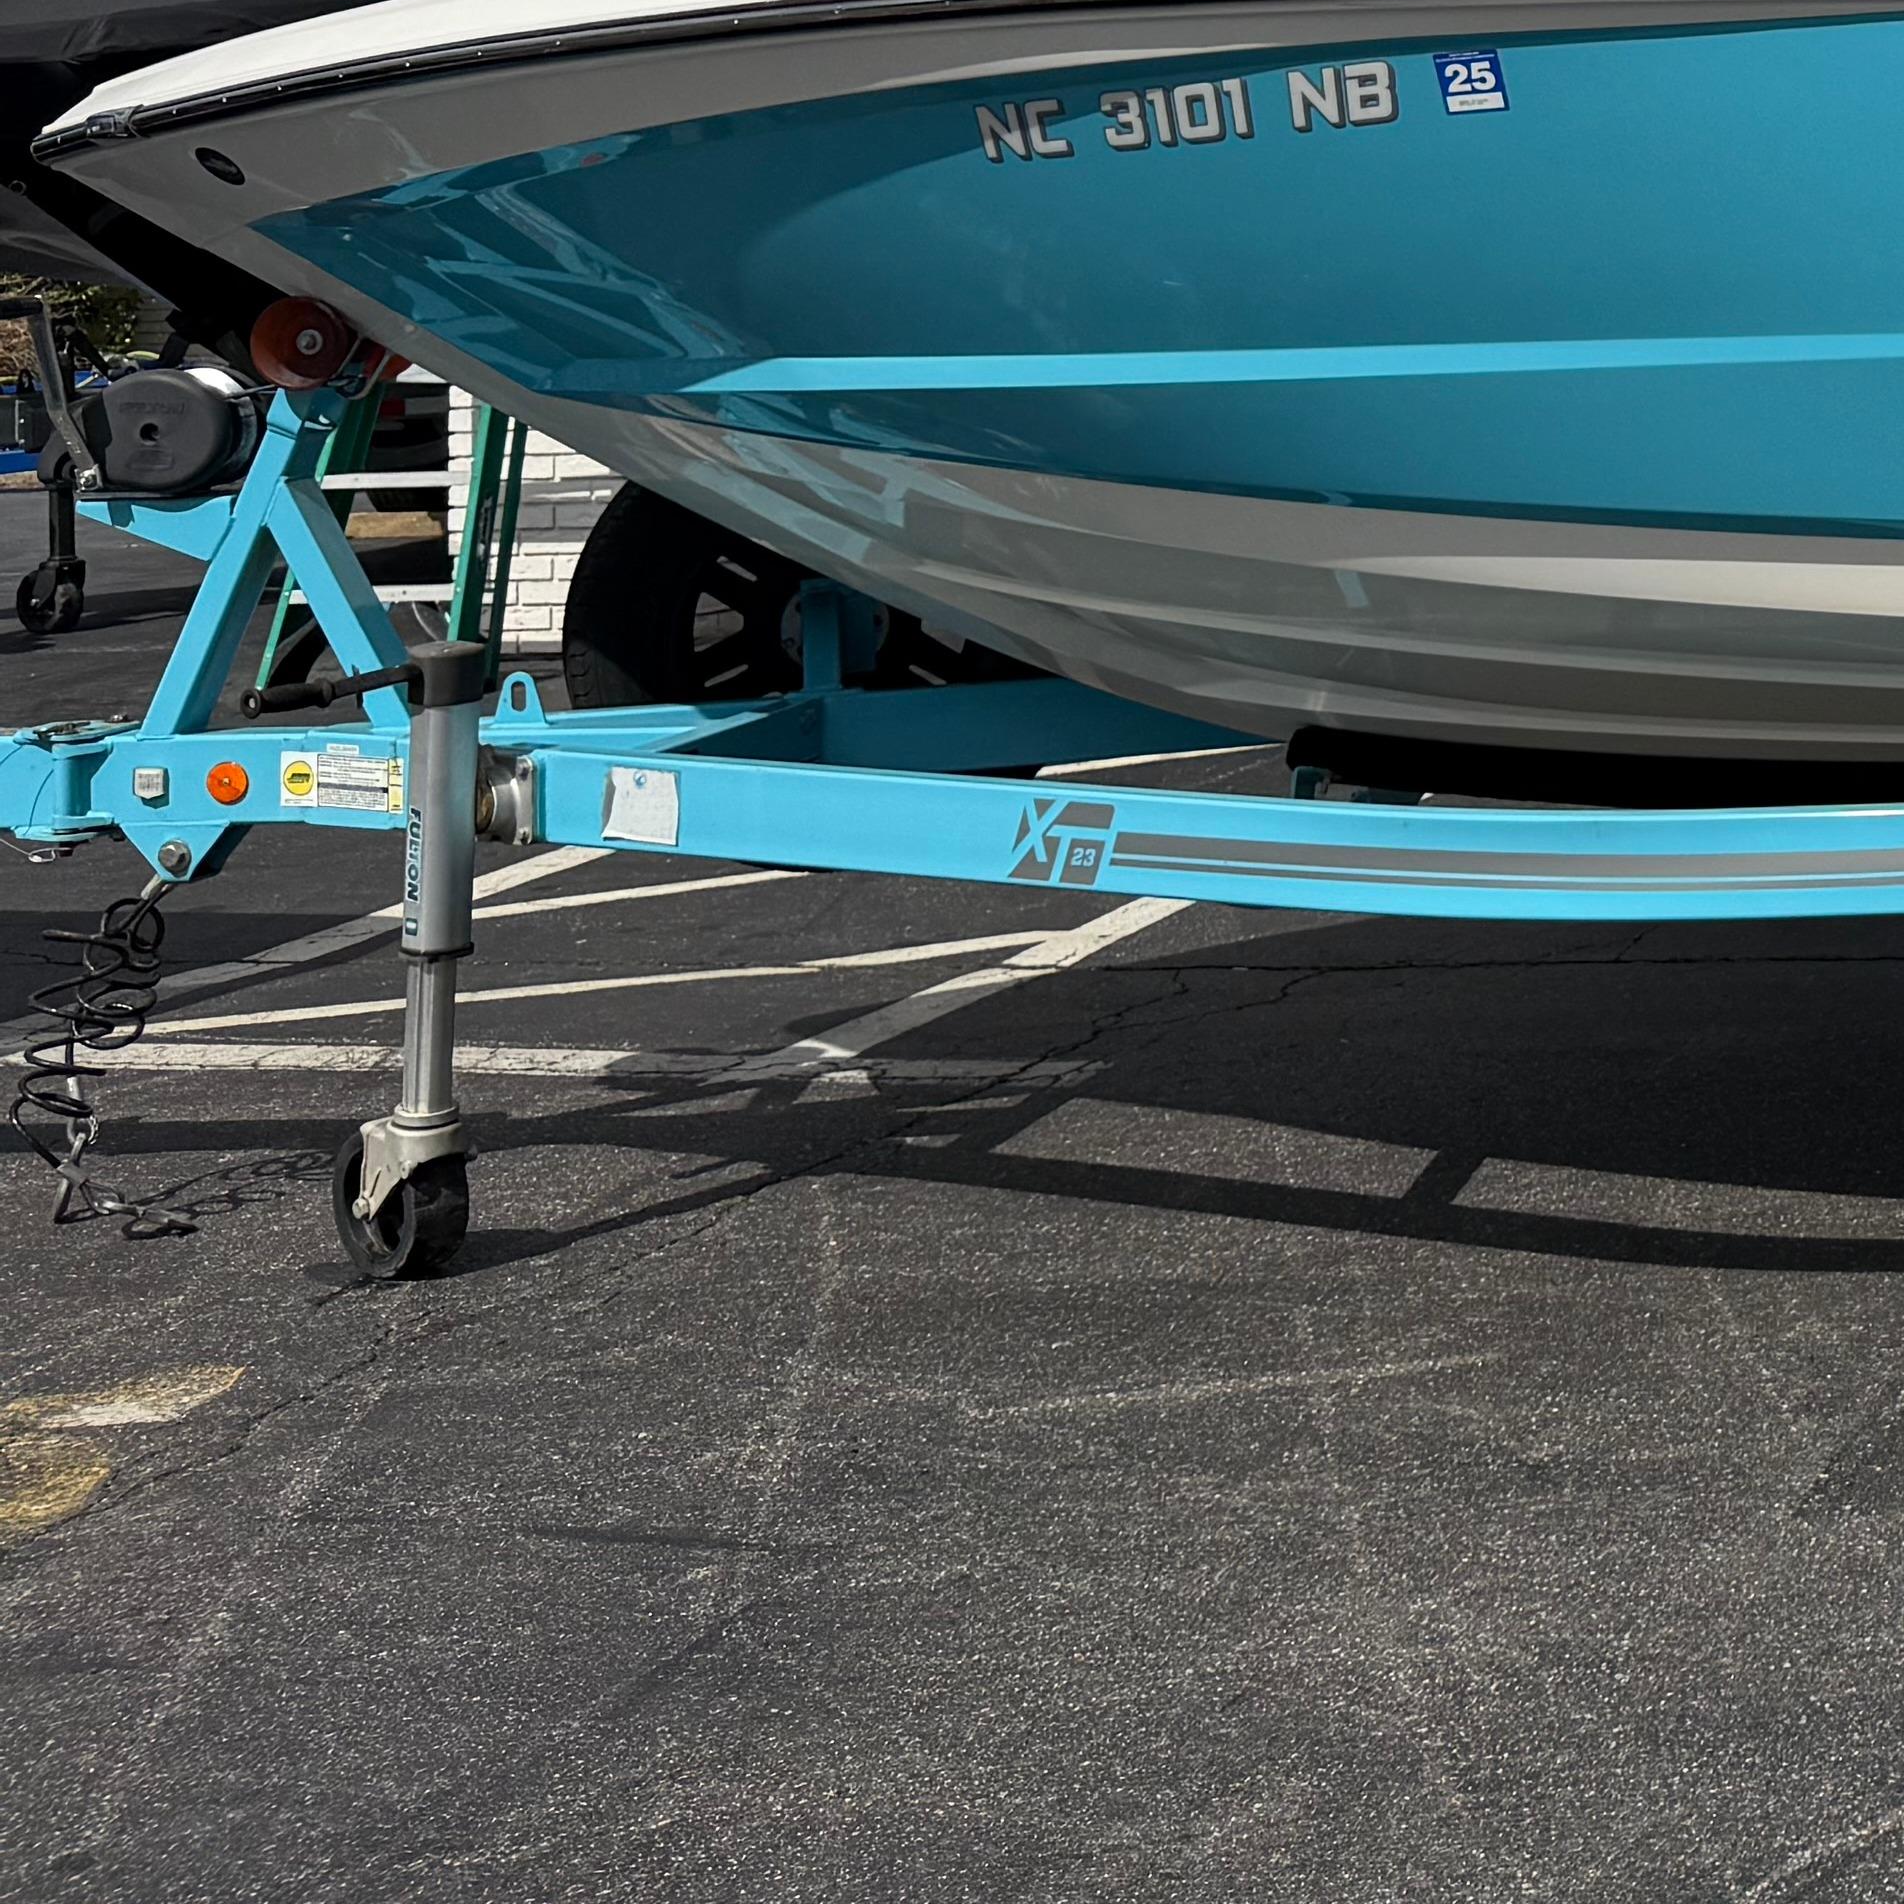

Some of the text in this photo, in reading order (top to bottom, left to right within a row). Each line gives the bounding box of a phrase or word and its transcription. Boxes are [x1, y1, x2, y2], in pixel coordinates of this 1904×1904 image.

[1444, 60, 1496, 93] 25
[973, 60, 1399, 163] NC 3101 NB
[406, 806, 423, 904] FULTON
[1070, 847, 1096, 867] 23
